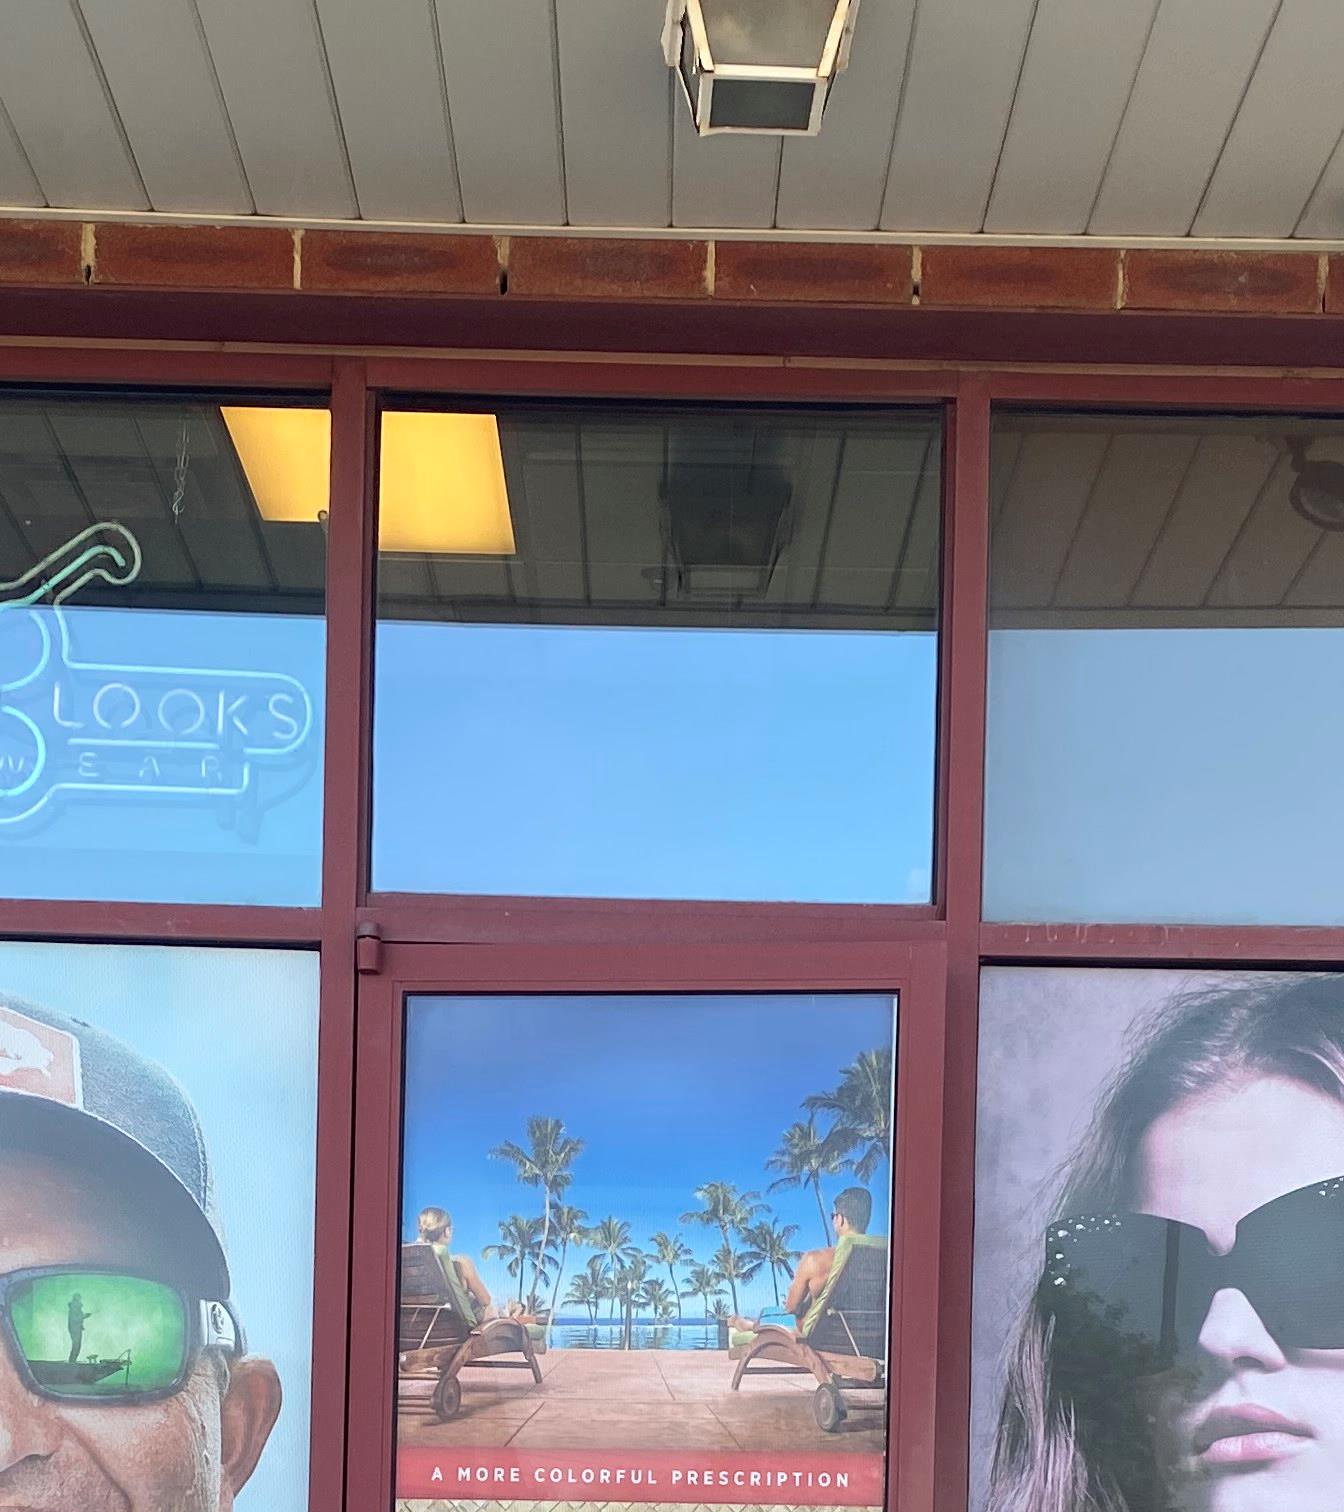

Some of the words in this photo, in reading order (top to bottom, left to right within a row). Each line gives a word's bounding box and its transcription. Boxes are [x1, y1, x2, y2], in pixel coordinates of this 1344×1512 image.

[53, 682, 299, 741] LOOKS
[431, 1466, 444, 1482] A
[457, 1467, 522, 1484] MORE
[533, 1467, 658, 1486] COLORFUL
[671, 1469, 851, 1489] PRESCRIPTION
